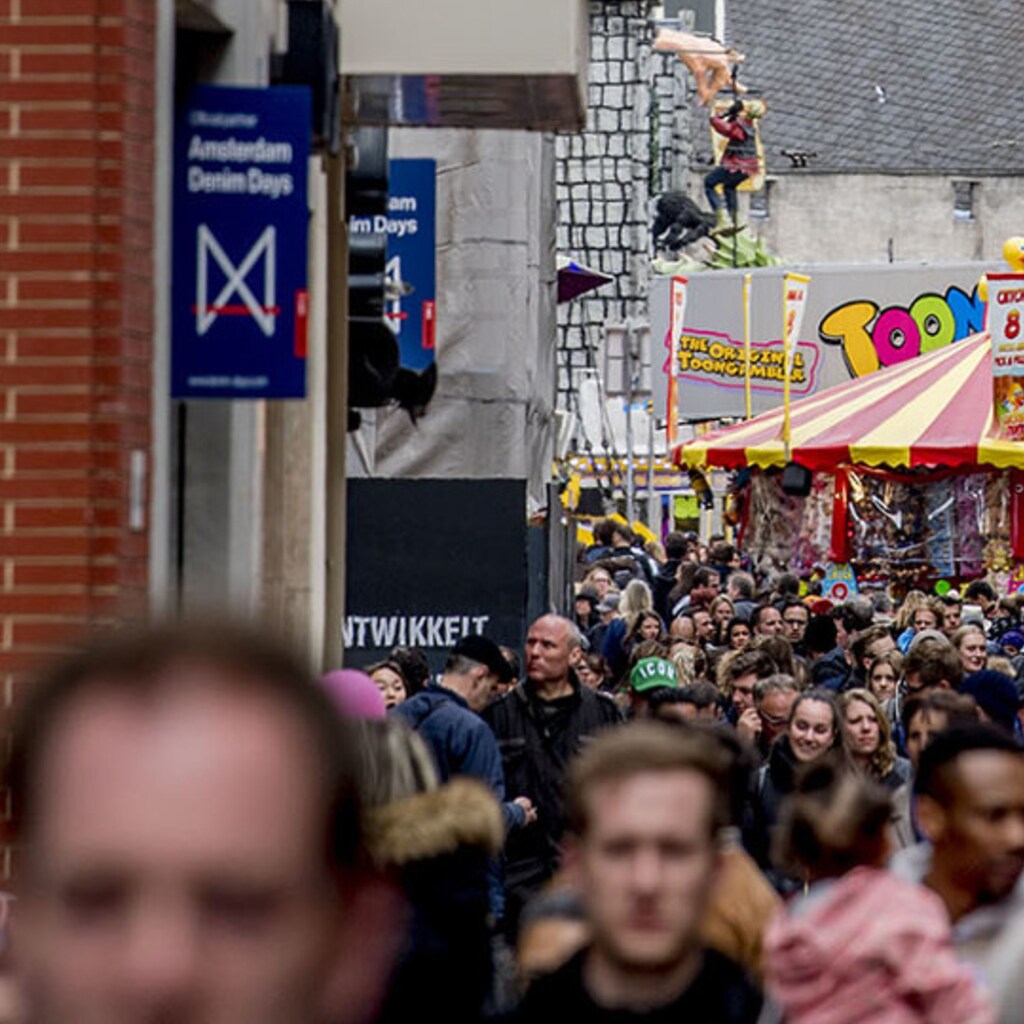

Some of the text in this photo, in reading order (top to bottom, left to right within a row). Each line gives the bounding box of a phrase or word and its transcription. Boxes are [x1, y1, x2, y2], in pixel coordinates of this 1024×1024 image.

[188, 136, 293, 163] Amsterdam
[188, 166, 294, 199] Denim Days
[374, 215, 418, 236] Days
[1004, 309, 1021, 340] 8
[680, 336, 804, 366] THE ORIGINL
[640, 662, 675, 679] ICON
